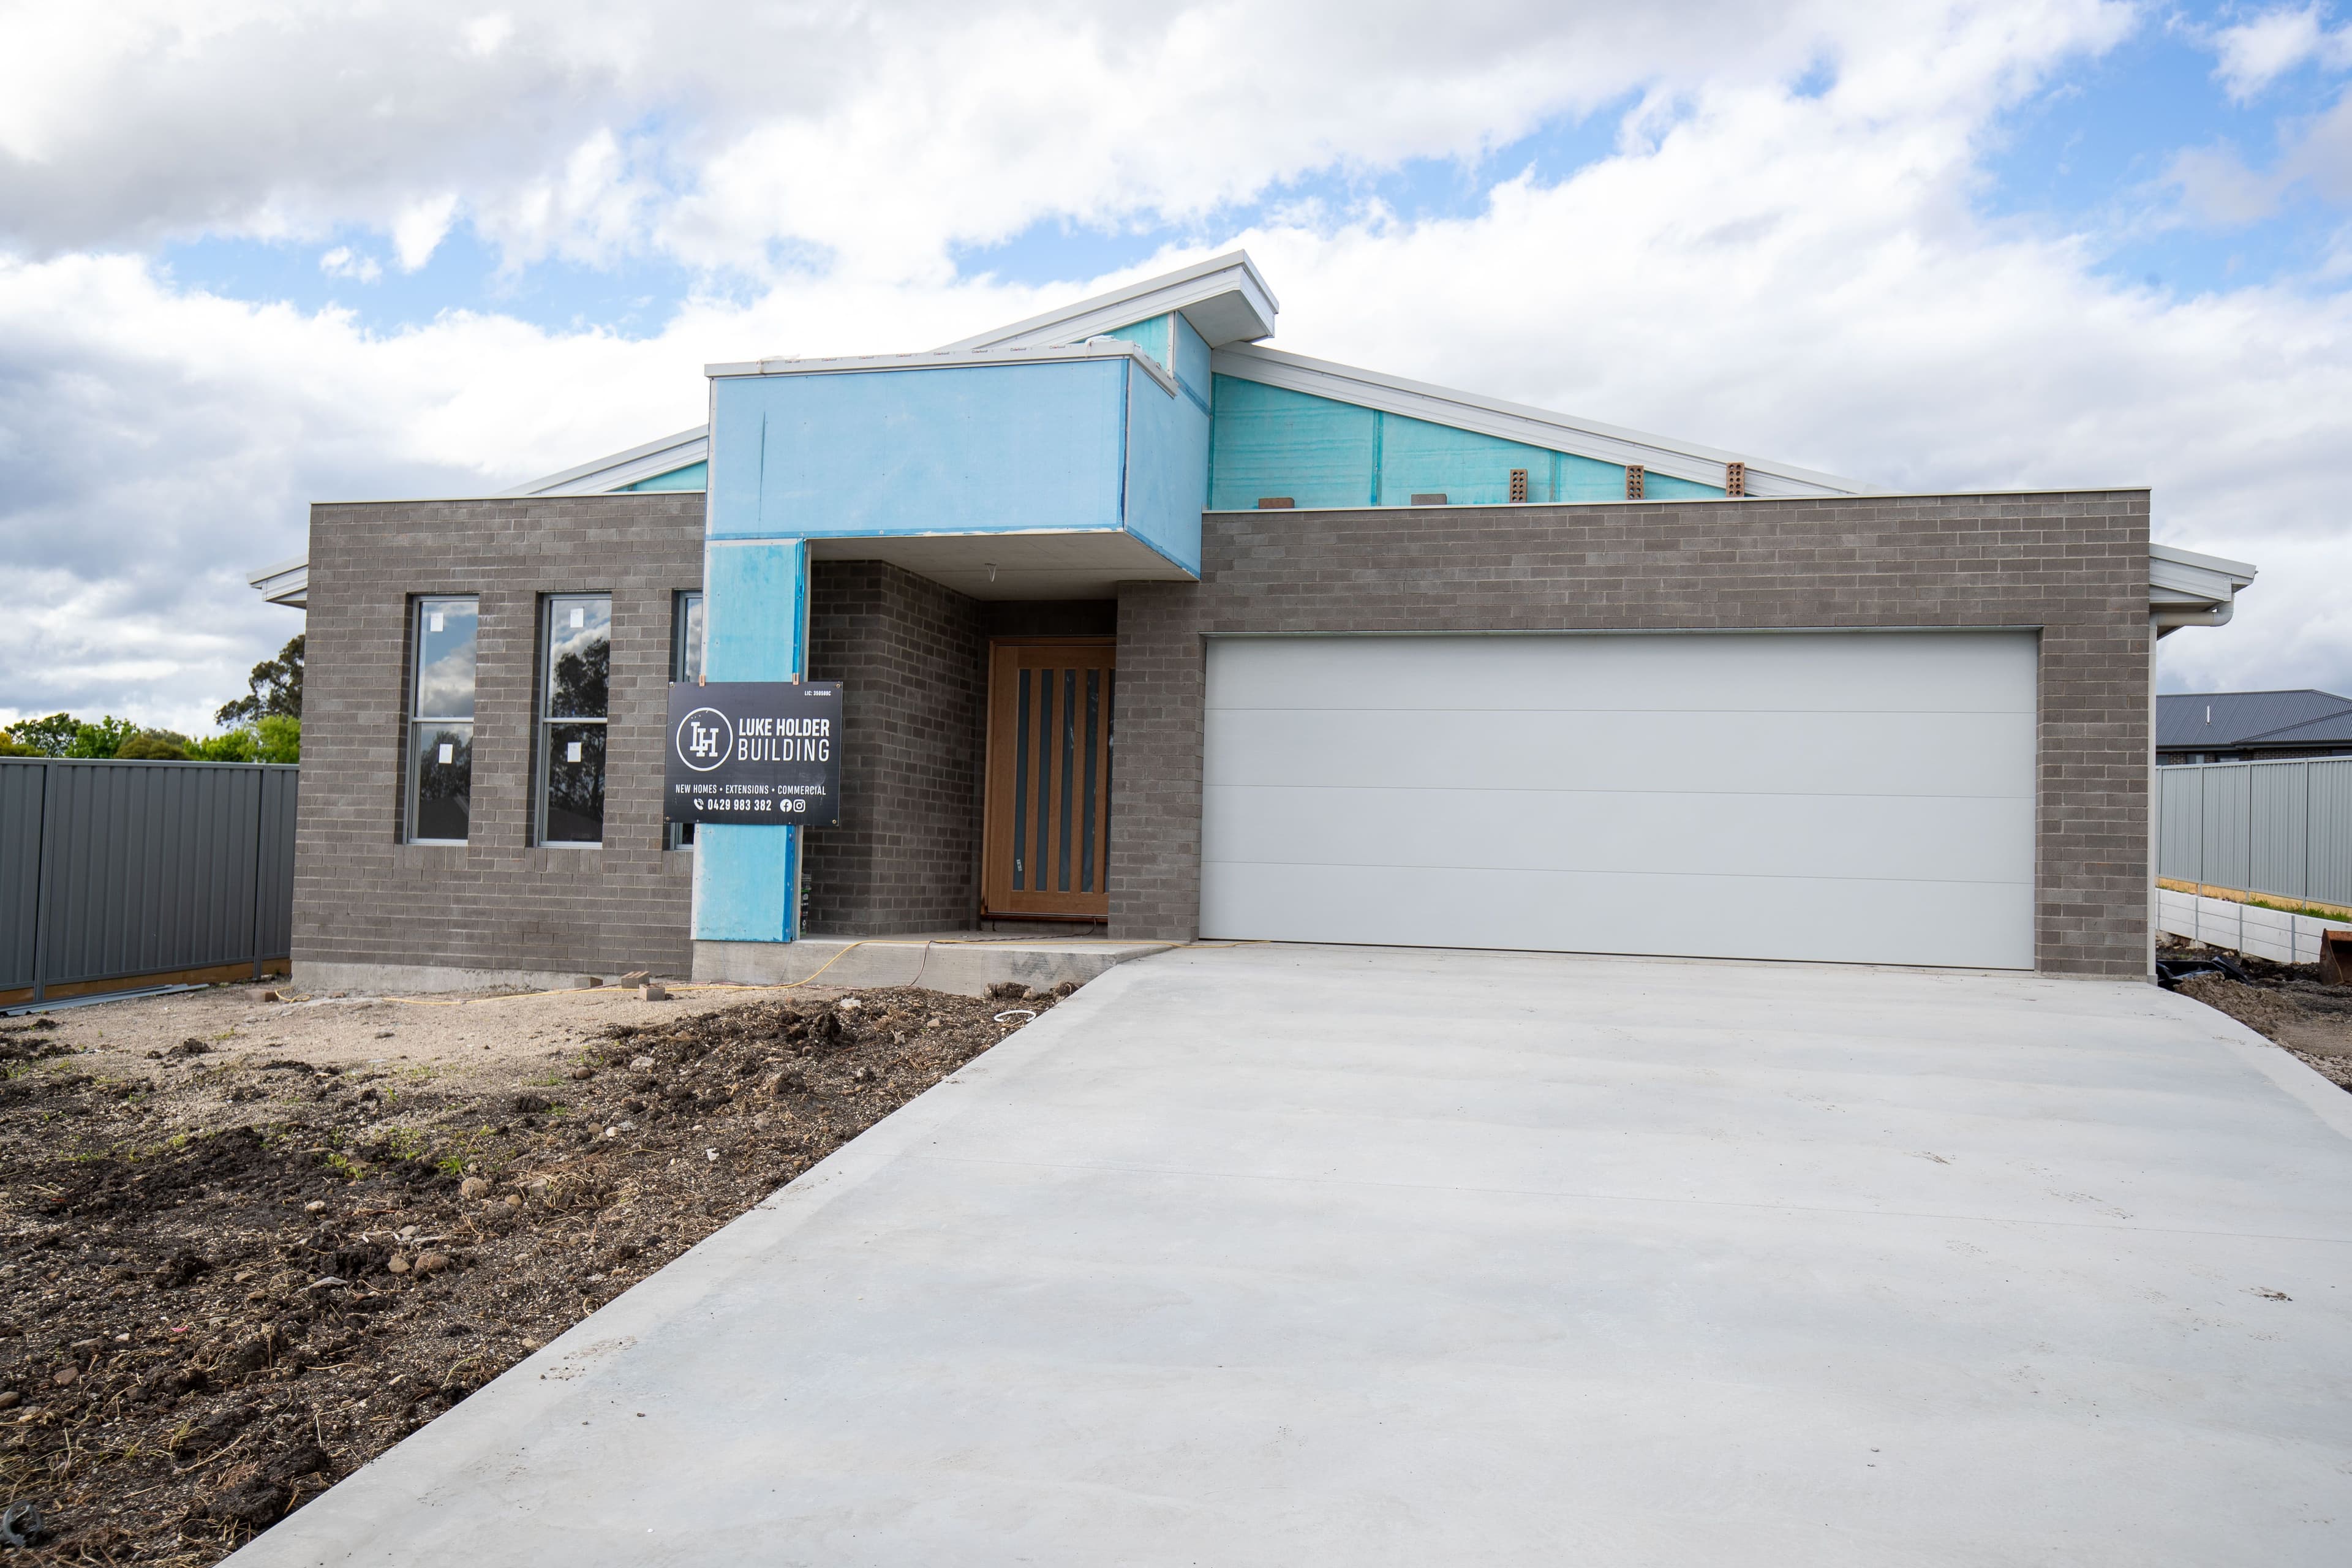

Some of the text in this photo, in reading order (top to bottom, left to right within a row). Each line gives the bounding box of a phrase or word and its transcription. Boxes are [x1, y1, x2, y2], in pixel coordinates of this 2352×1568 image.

[739, 718, 830, 737] LUKE HOLDER
[737, 738, 829, 762] BUILDING
[676, 784, 826, 795] NEW HOMES EXTENSIONS COMMERCIAL
[707, 799, 772, 812] 0429 983 382
